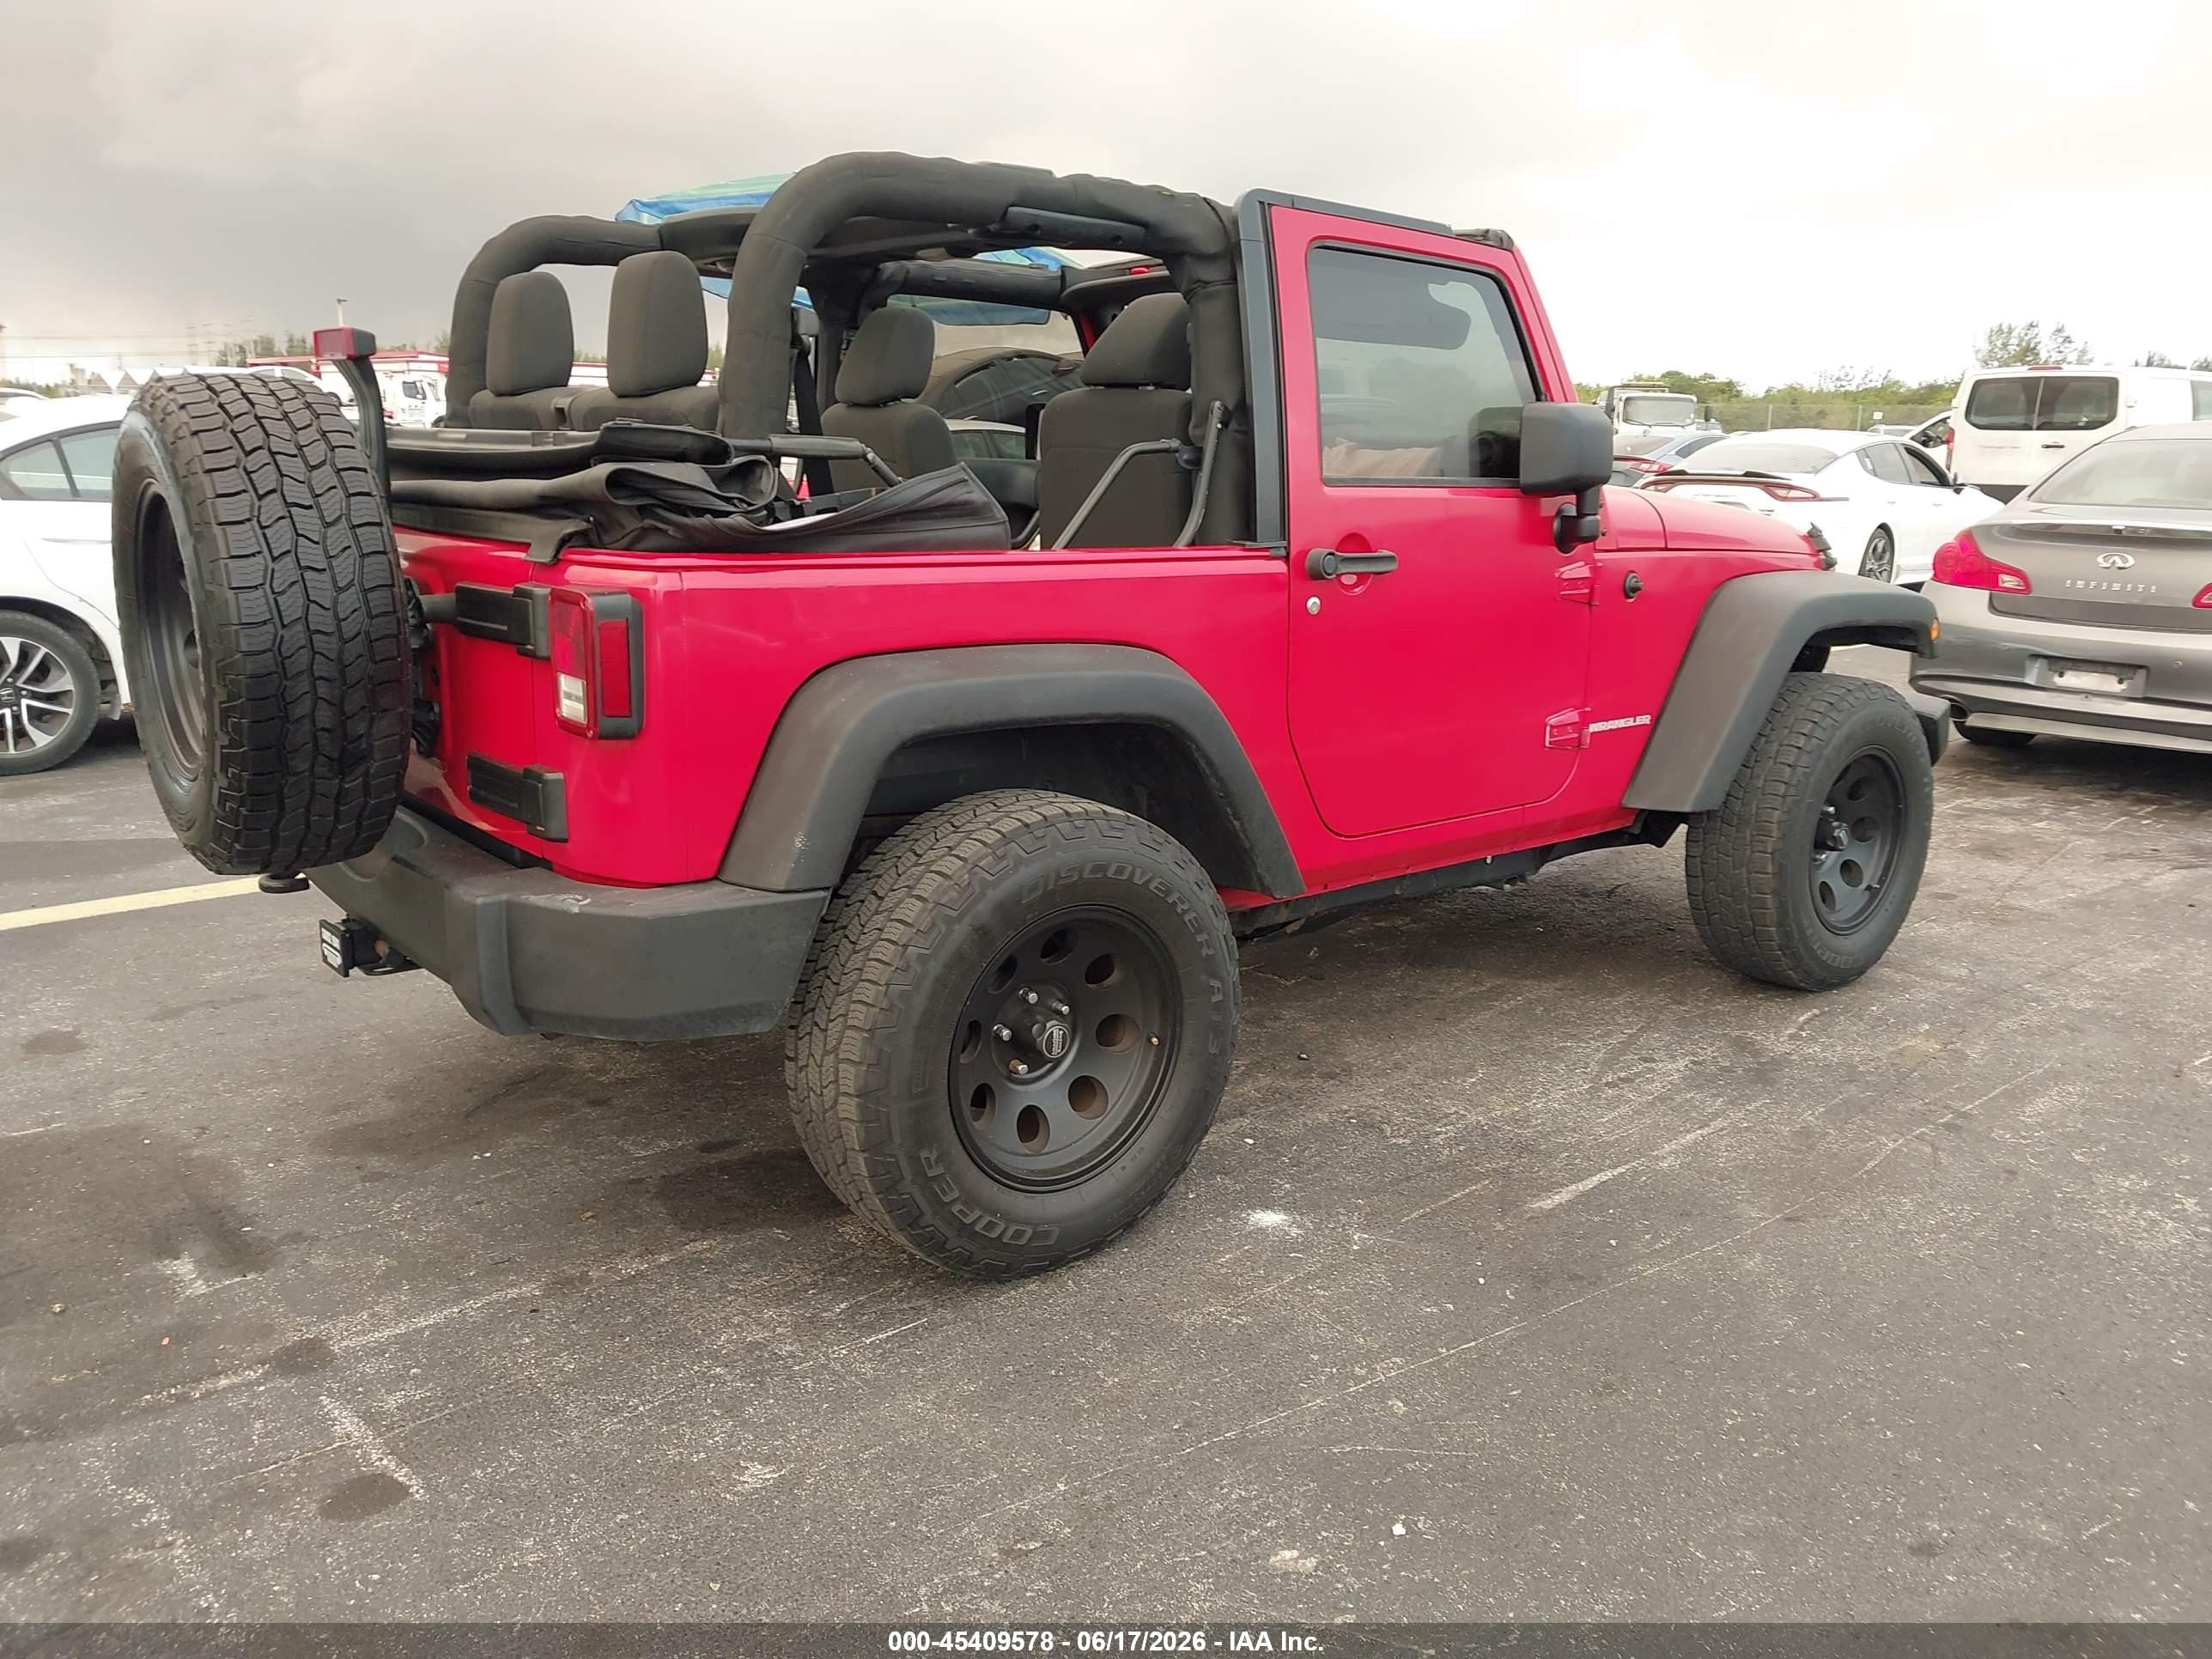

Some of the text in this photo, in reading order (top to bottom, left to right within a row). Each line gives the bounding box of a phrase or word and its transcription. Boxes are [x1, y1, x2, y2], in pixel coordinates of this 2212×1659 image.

[2063, 579, 2157, 594] INFINITI
[1589, 714, 1652, 733] WRANGLER
[1021, 860, 1215, 958] DISCOVERER
[920, 1146, 1060, 1246] COOPER
